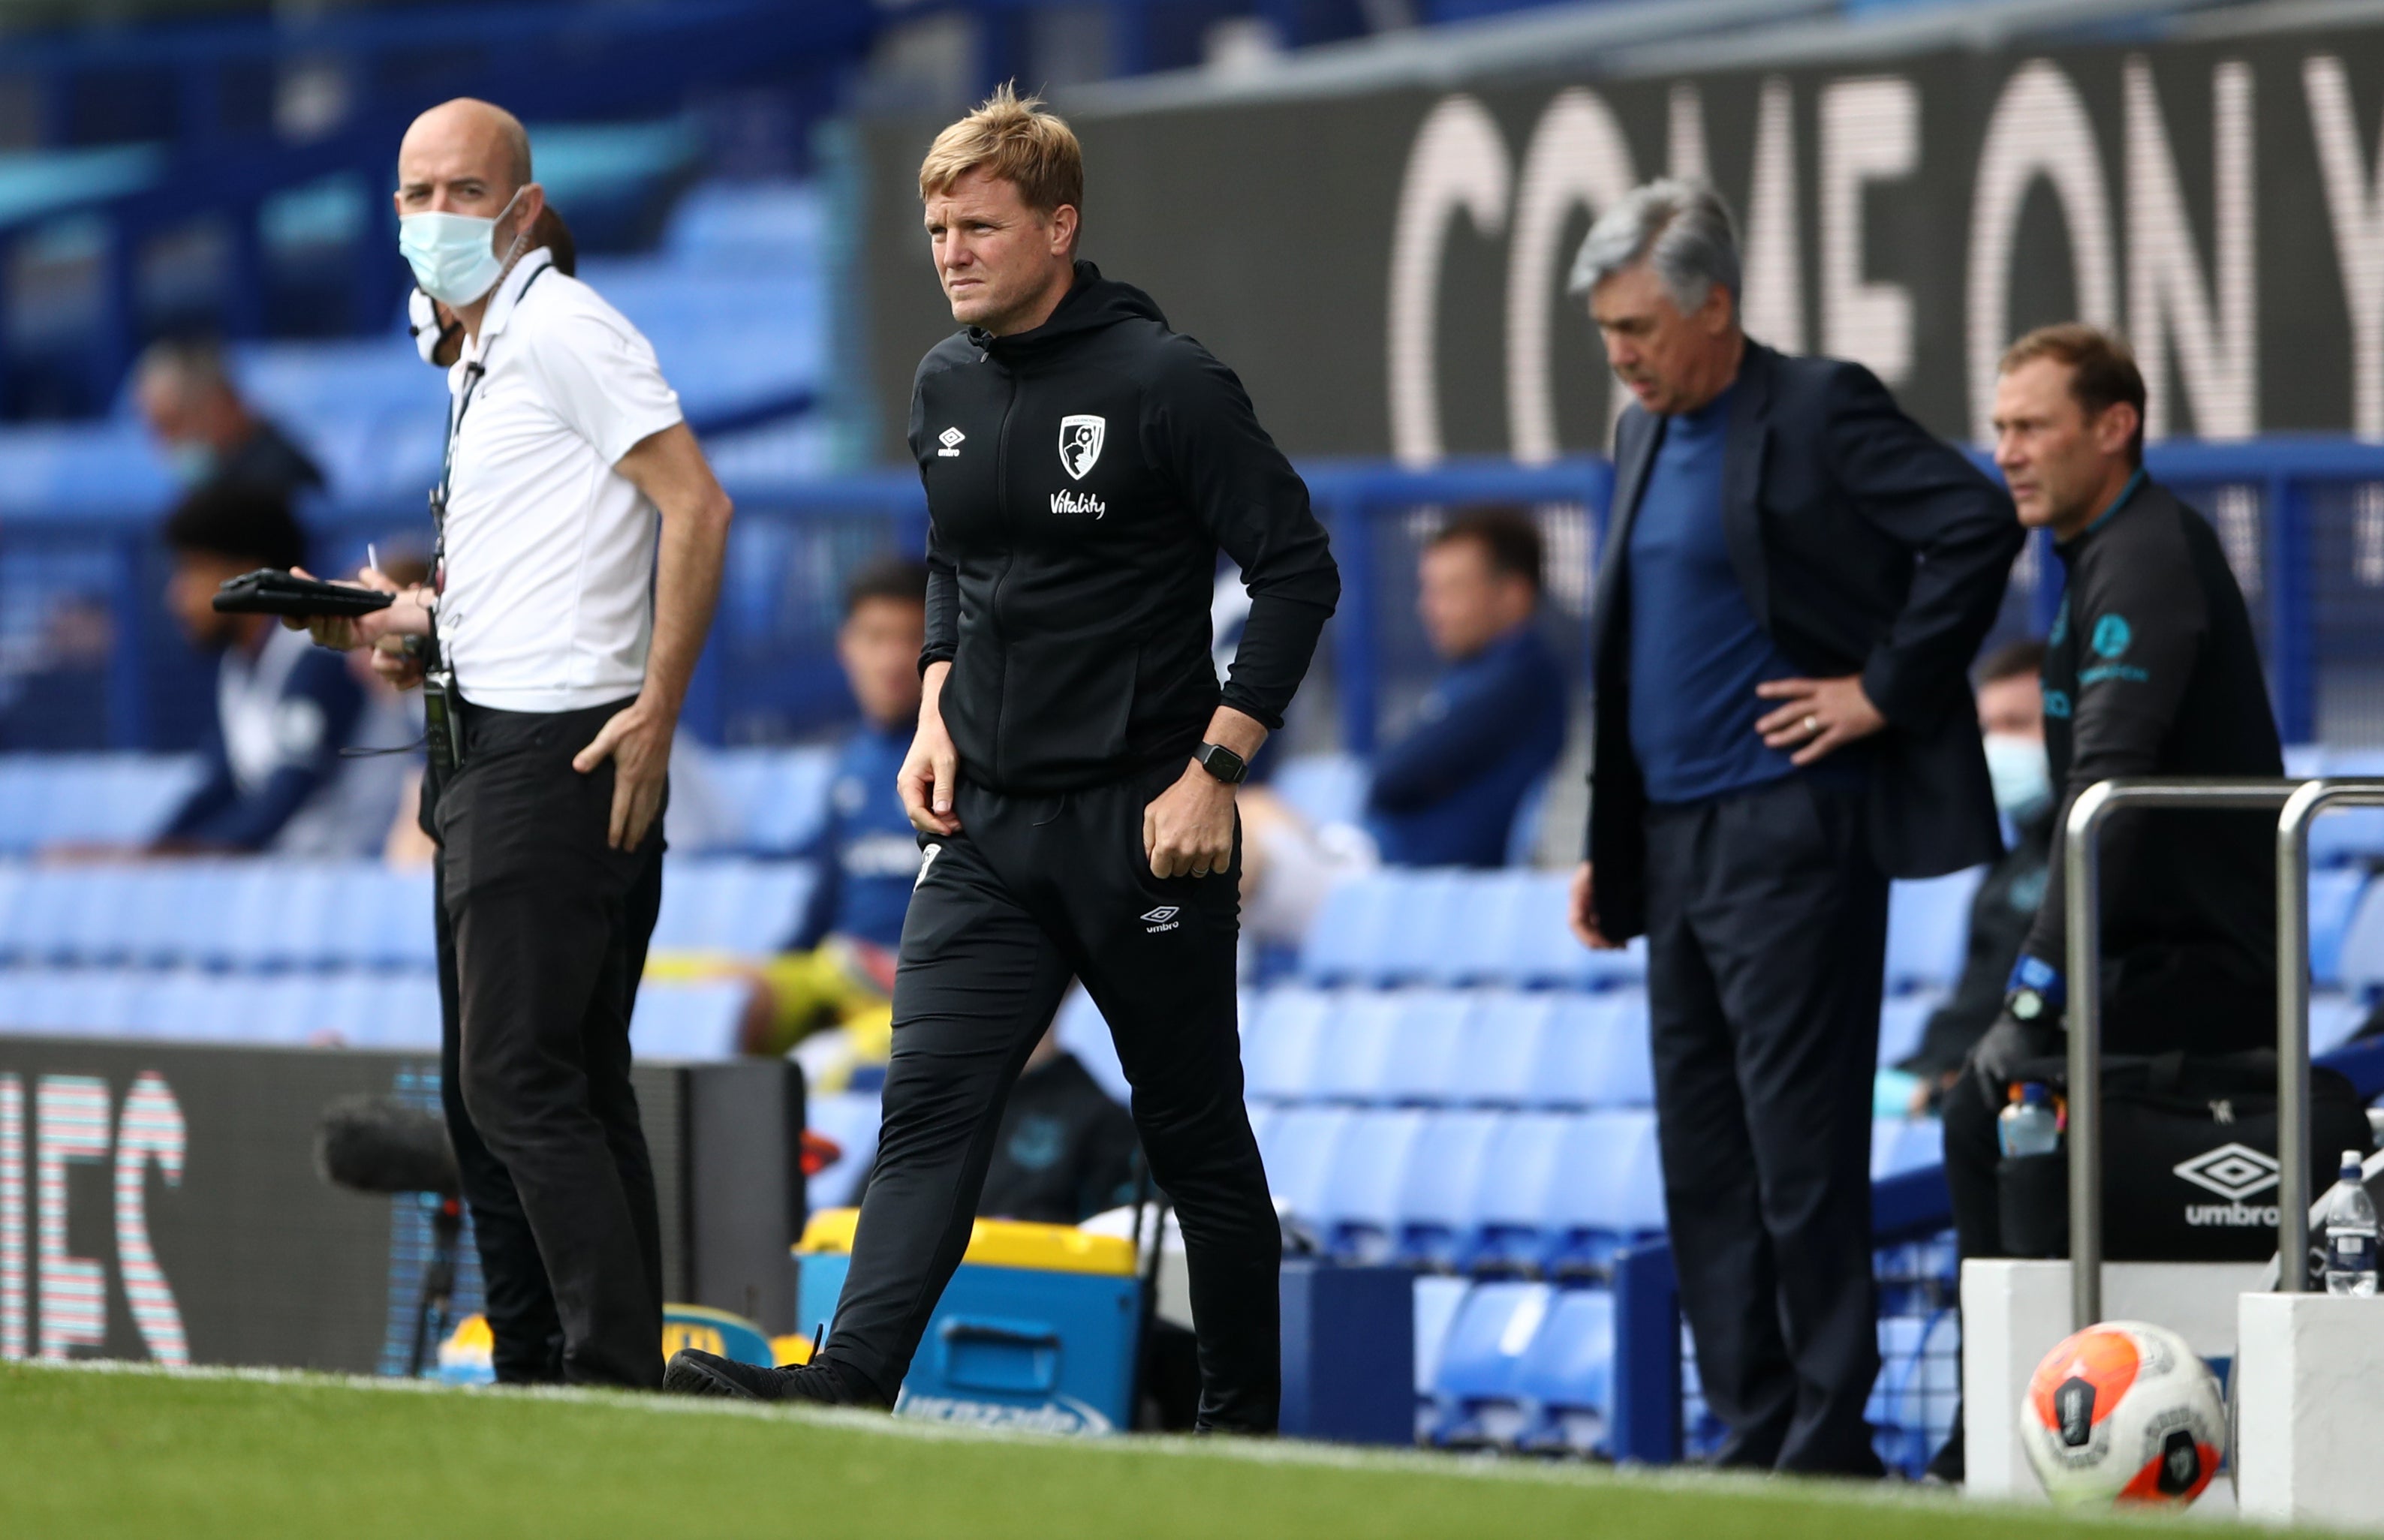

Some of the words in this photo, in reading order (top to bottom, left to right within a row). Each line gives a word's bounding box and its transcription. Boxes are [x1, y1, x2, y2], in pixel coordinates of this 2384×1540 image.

[1962, 54, 2258, 452] ON
[938, 447, 960, 457] umbro
[1050, 489, 1106, 520] Vitality
[1146, 921, 1179, 933] umbro
[2185, 1200, 2280, 1227] umbro
